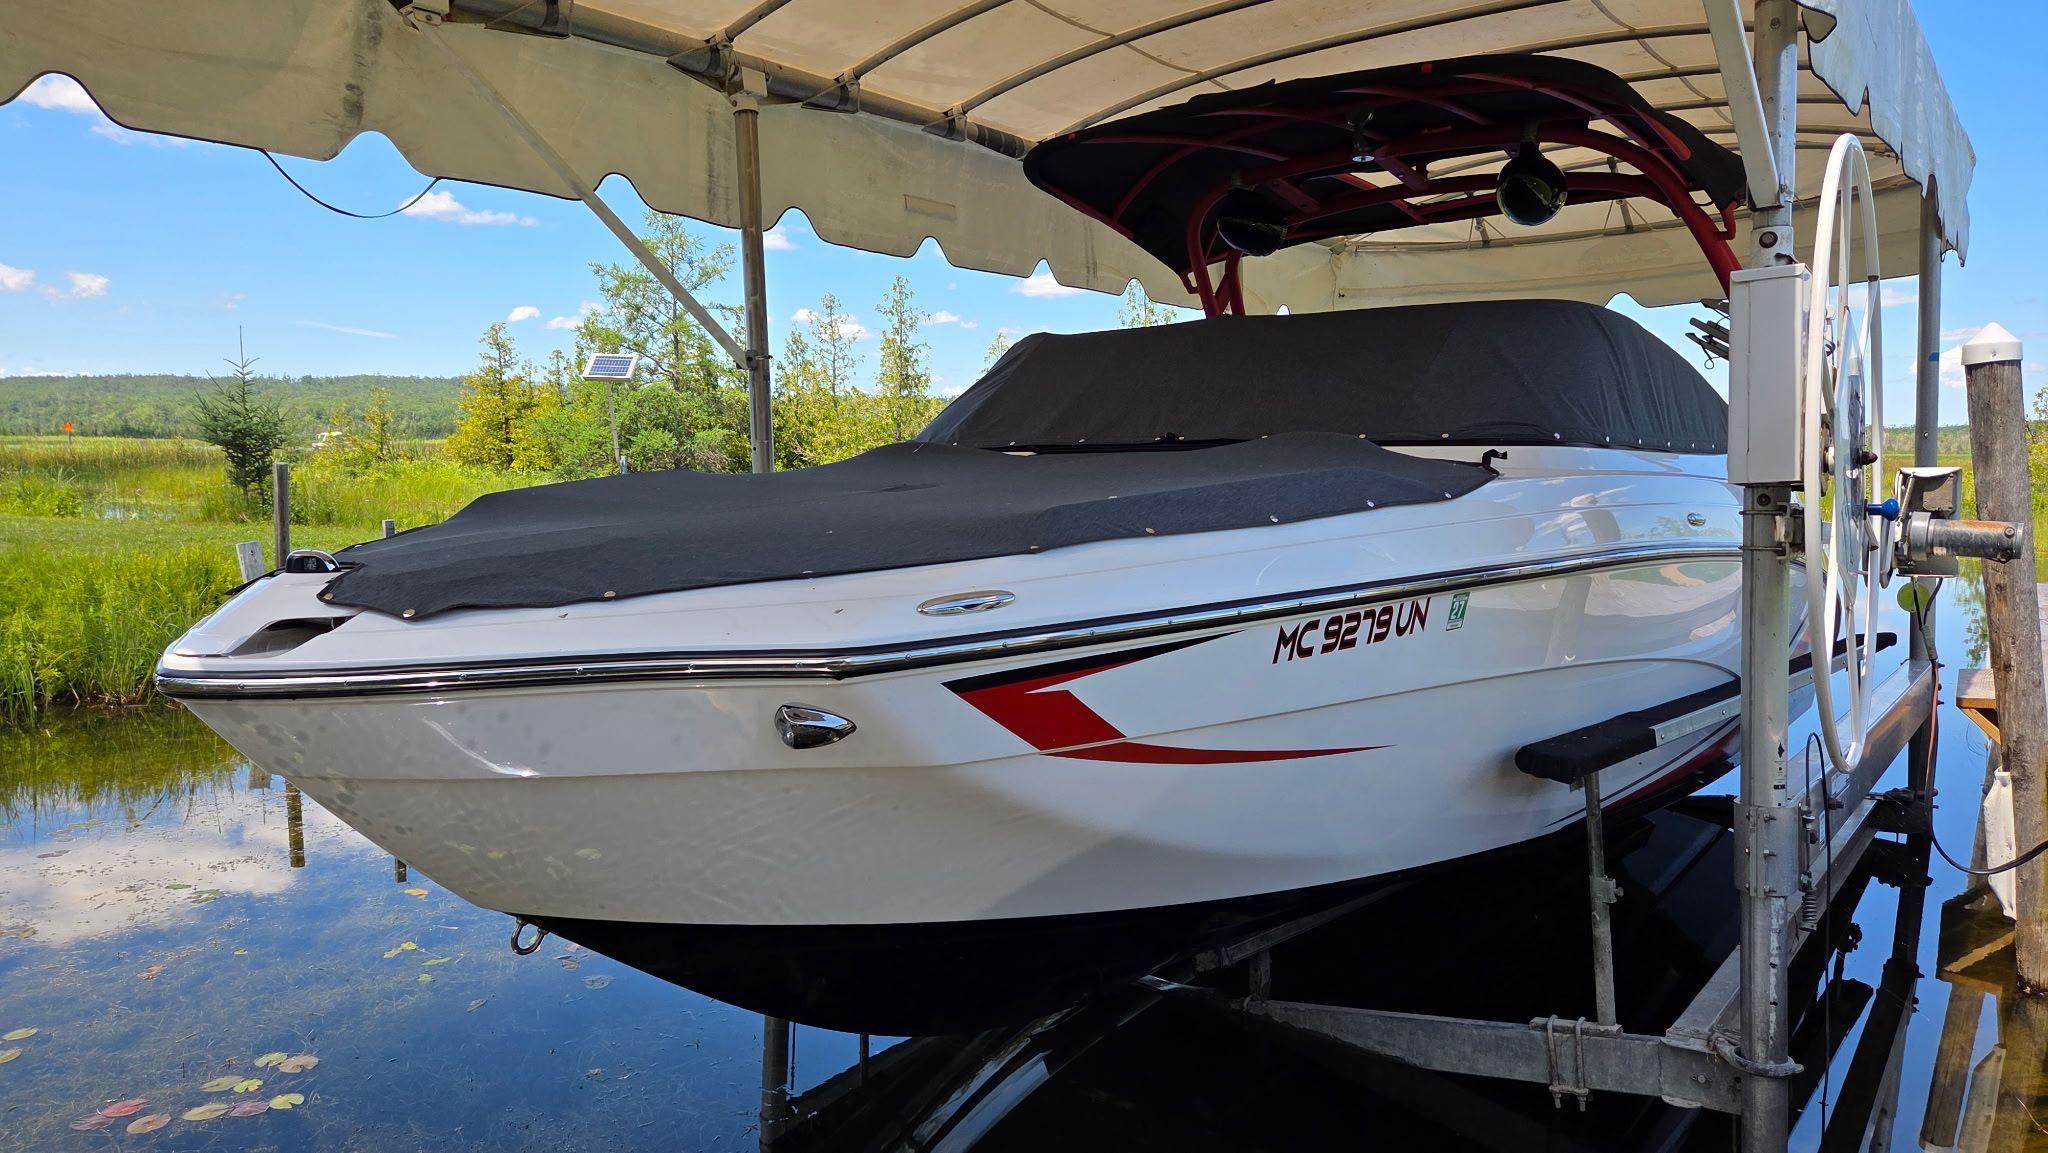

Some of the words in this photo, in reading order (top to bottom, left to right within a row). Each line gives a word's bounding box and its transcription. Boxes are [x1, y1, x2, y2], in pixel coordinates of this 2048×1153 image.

[1272, 618, 1320, 664] MC
[1320, 605, 1393, 654] 9279
[1395, 597, 1431, 637] UN
[1450, 600, 1465, 620] 27
